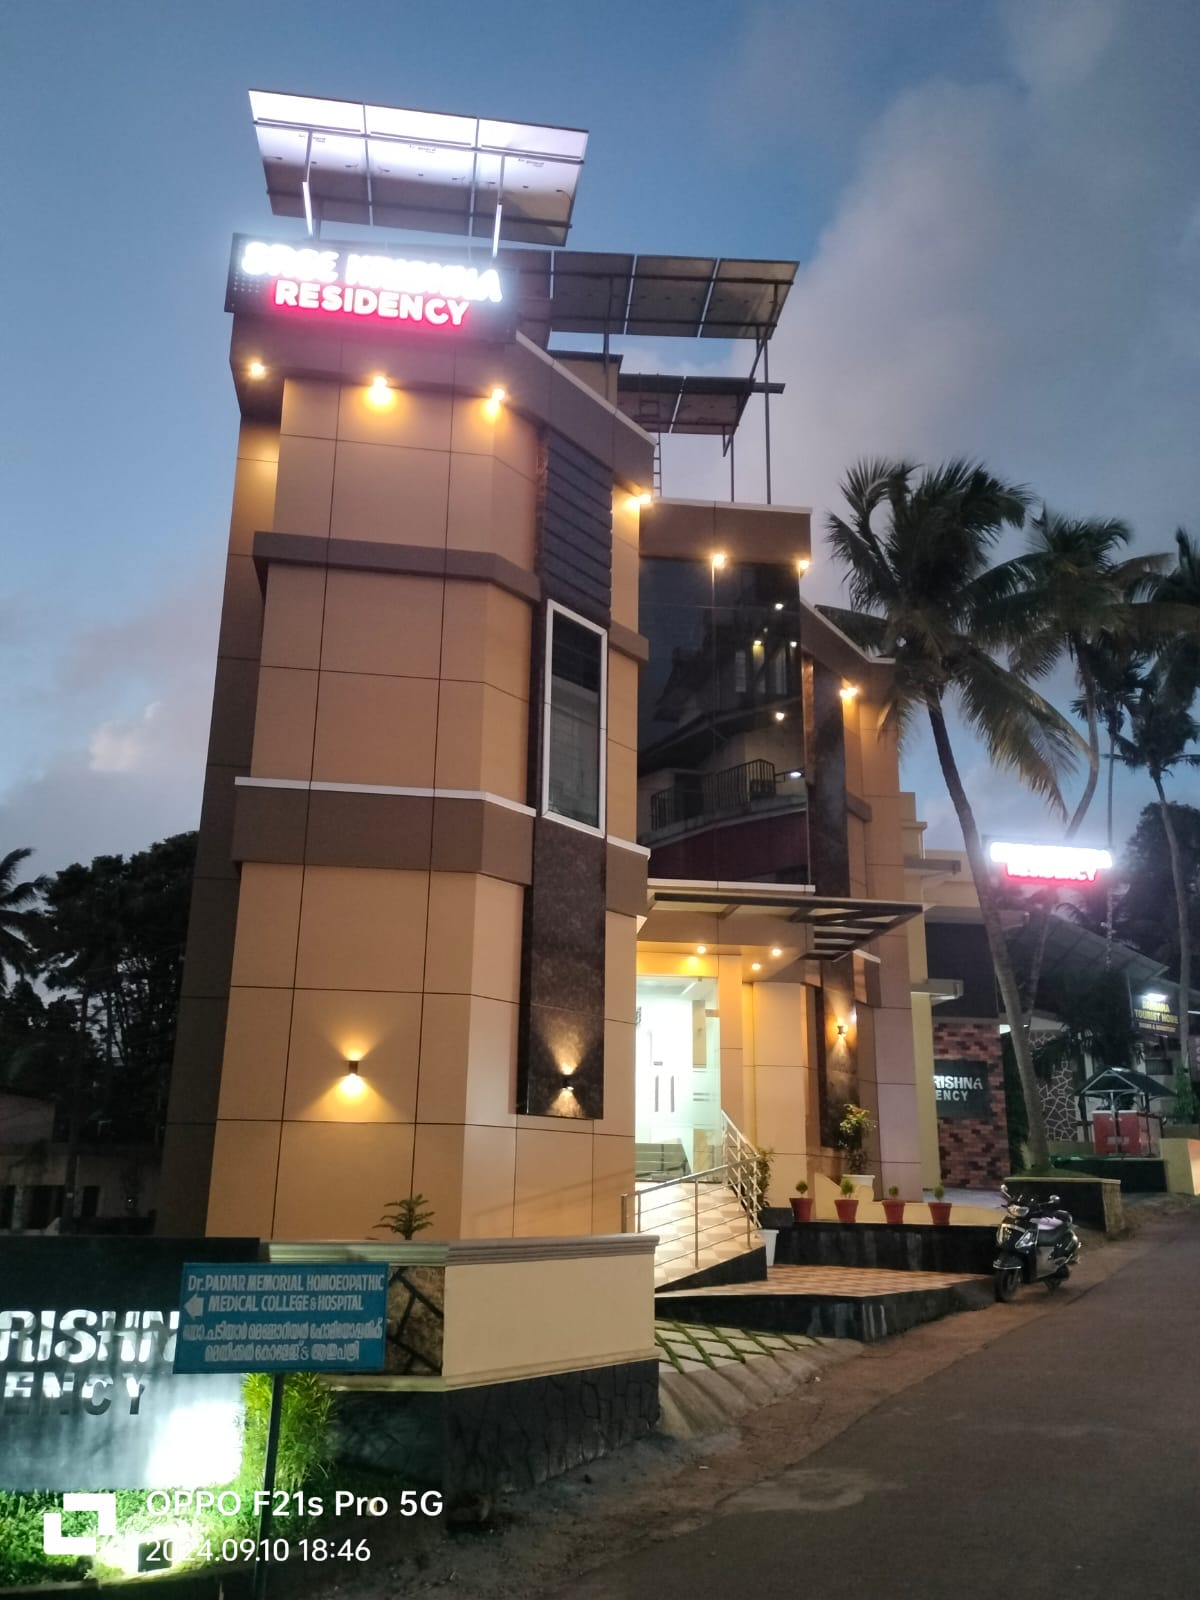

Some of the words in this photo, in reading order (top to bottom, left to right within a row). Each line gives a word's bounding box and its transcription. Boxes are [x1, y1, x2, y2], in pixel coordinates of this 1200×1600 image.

[275, 280, 469, 326] RESIDENCY
[935, 1089, 969, 1102] ENCY
[247, 1274, 304, 1291] MEMORIAL
[307, 1274, 385, 1291] HOMOEOPATHIC
[208, 1295, 258, 1312] MEDICAL
[317, 1295, 363, 1311] HOSPITAL
[3, 1371, 150, 1415] ENCY
